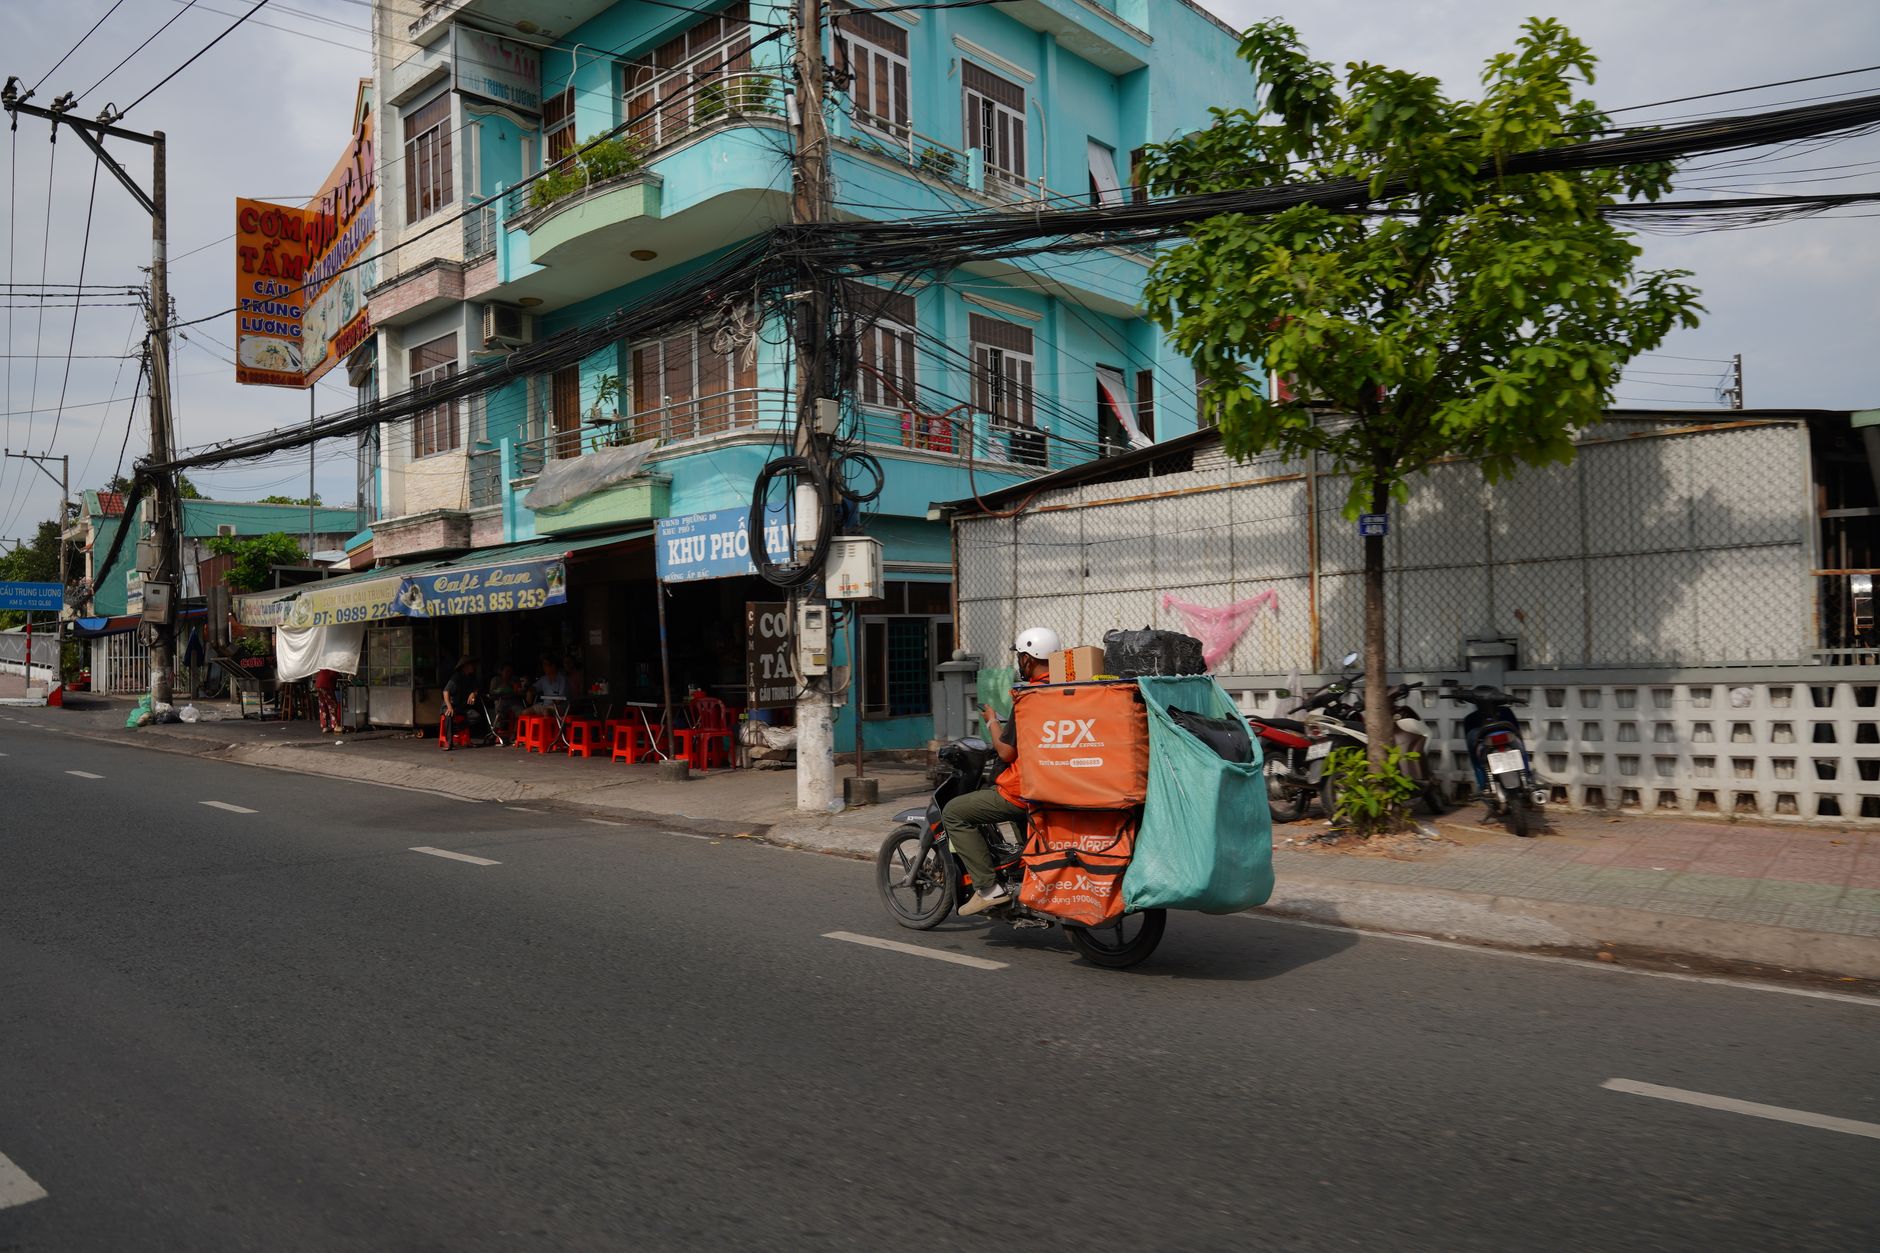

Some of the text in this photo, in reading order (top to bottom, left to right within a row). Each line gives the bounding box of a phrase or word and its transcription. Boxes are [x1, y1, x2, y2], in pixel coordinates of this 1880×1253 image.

[483, 77, 509, 100] TRUNG
[240, 207, 303, 242] CƠM
[239, 238, 303, 281] TẤM
[323, 232, 349, 282] TRUNG
[253, 279, 290, 298] CẦU
[241, 298, 302, 319] TRUNG
[241, 317, 302, 337] LƯƠNG
[709, 513, 717, 521] 10
[667, 516, 796, 566] KHU PHỐ ĂN
[484, 569, 532, 587] Lan
[15, 588, 38, 597] TRUNG
[489, 591, 514, 611] 855
[517, 588, 547, 608] 253
[313, 611, 332, 625] ĐT:
[336, 606, 367, 623] 0989
[760, 641, 795, 679] TẤ
[1041, 719, 1097, 748] SPX
